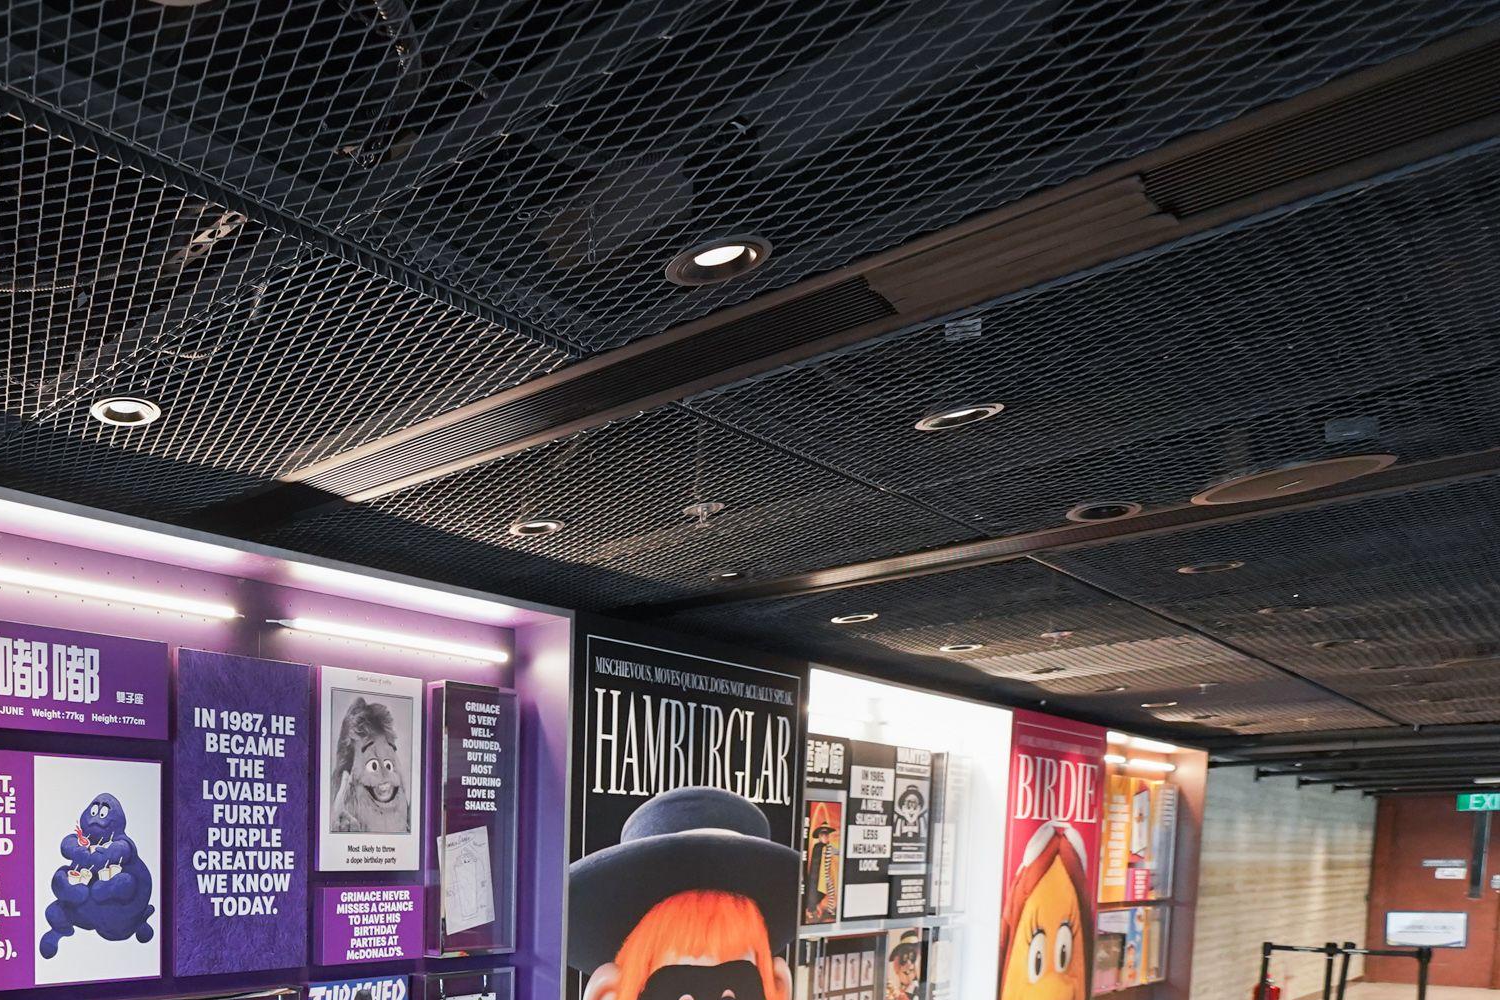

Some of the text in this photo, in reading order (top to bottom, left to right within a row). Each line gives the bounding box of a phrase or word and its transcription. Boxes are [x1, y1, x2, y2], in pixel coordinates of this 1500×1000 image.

[595, 656, 653, 683] MISCHIEVOUS,
[655, 666, 680, 686] MOVES
[465, 701, 500, 714] GRIMACE
[194, 707, 296, 737] IN 1987, HE
[468, 714, 497, 726] IS VERY
[471, 727, 494, 738] WELL-
[205, 732, 286, 758] BECAME
[462, 739, 502, 752] ROUNDED,
[592, 687, 791, 807] HAMBURGLAR
[467, 751, 497, 763] BUT HIS
[226, 757, 265, 779] THE
[471, 764, 493, 774] MOST
[461, 776, 502, 787] ENDURING
[202, 779, 287, 803] LOVABLE
[467, 788, 495, 799] LOVE IS
[1013, 753, 1098, 824] BIRDIE
[465, 800, 497, 811] SHAKES.
[213, 803, 278, 825] FURRY
[207, 827, 282, 848] PURPLE
[863, 829, 878, 840] LESS
[852, 843, 887, 855] MENACING
[192, 850, 295, 871] CREATURE
[197, 872, 291, 894] WE KNOW
[340, 890, 410, 902] GRIMACE NEVER
[210, 895, 278, 917] TODAY.
[336, 901, 414, 914] MISSES A CHANCE
[348, 913, 401, 925] TO HAVE HIS
[353, 925, 397, 937] BIRTHDAY
[350, 935, 399, 948] PARTIES AT
[346, 947, 404, 960] McDONALD'S.
